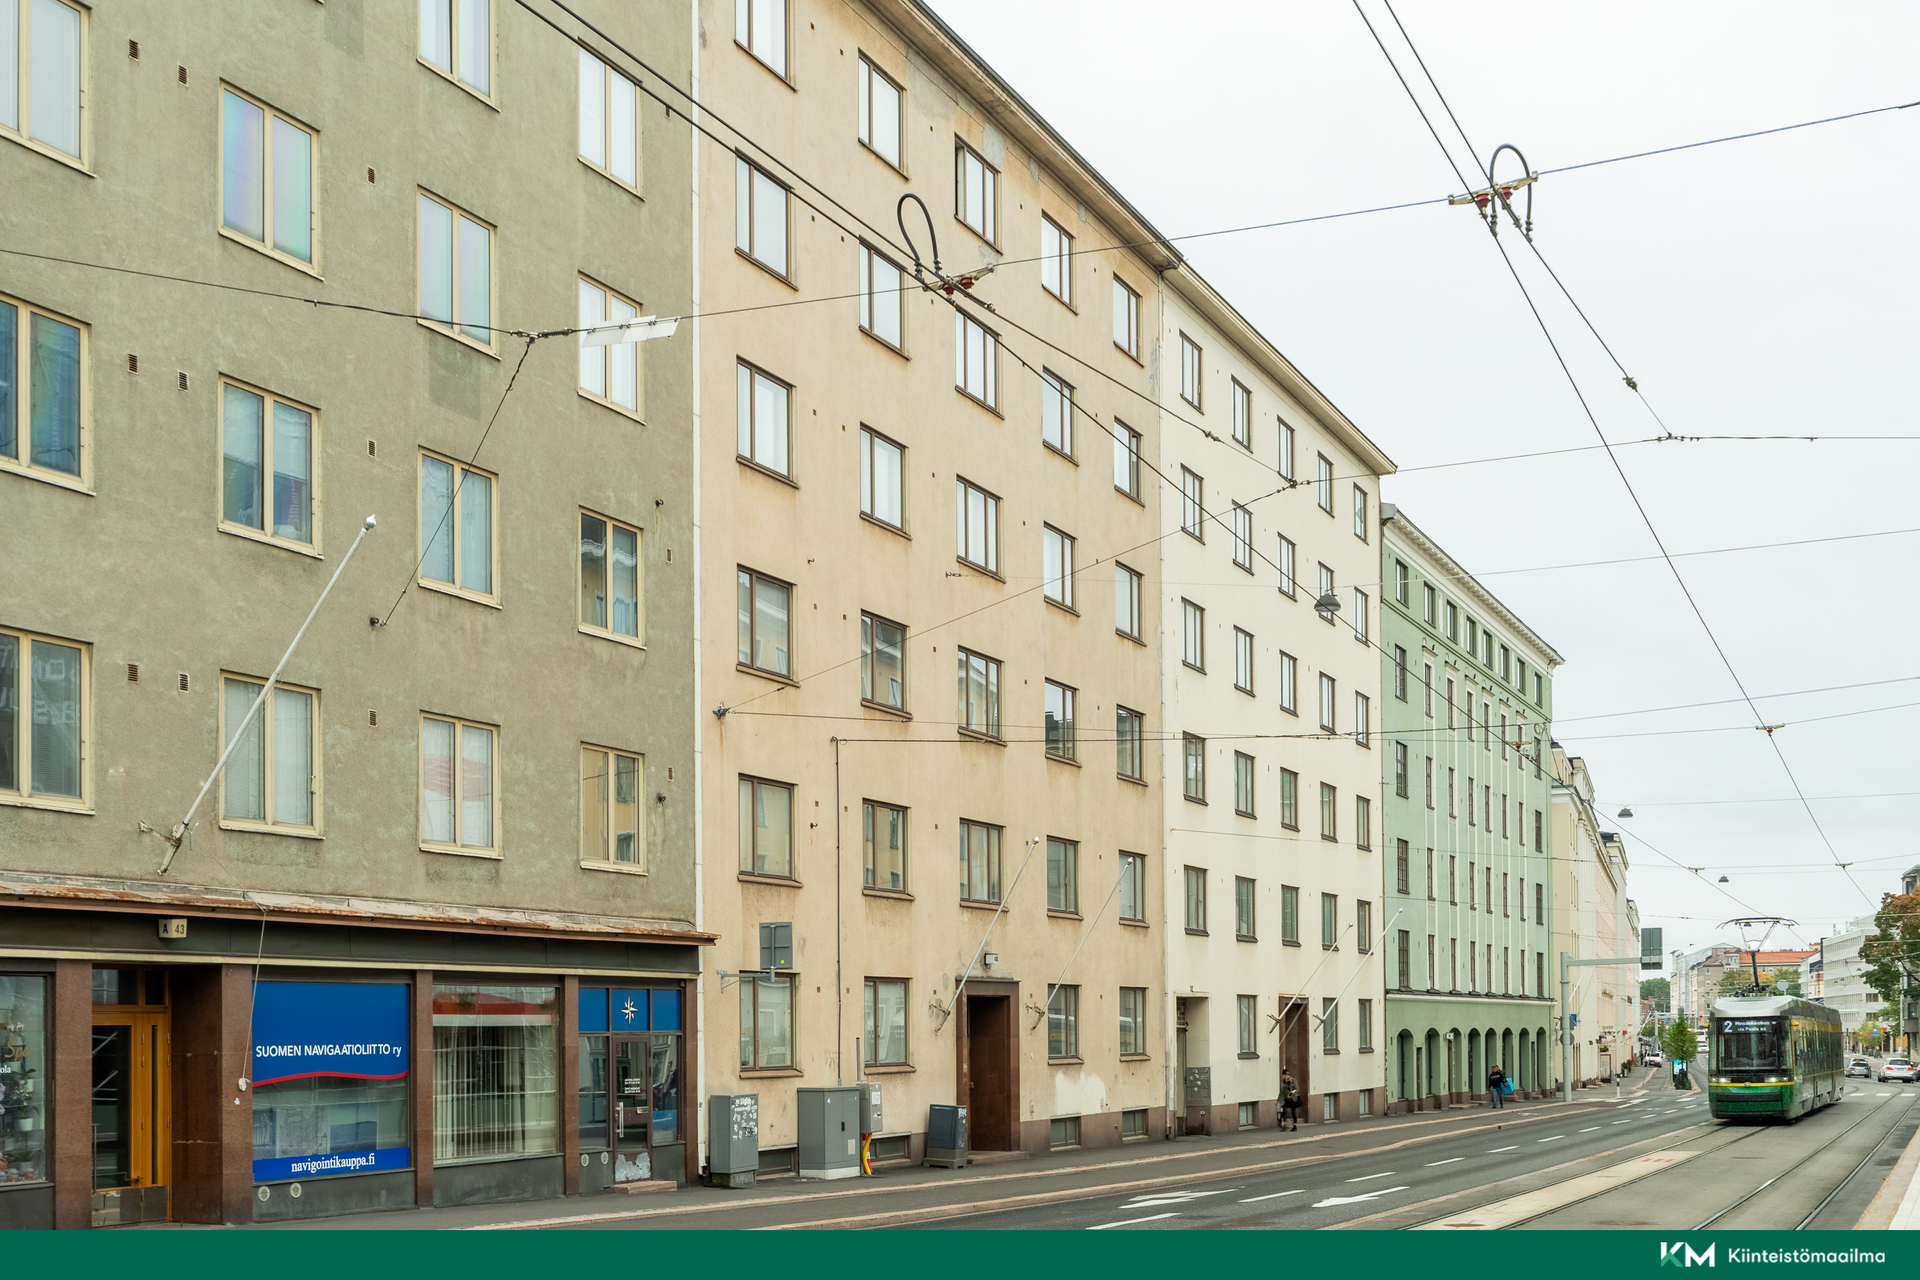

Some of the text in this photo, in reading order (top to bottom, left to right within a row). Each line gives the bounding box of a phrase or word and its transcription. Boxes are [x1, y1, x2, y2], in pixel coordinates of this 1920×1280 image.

[163, 924, 185, 935] A 43
[1724, 1020, 1733, 1033] 2
[256, 1044, 402, 1057] SUOMEN NAVIGAATIOLIITTO ry
[291, 1153, 375, 1173] navigointikauppa.fi
